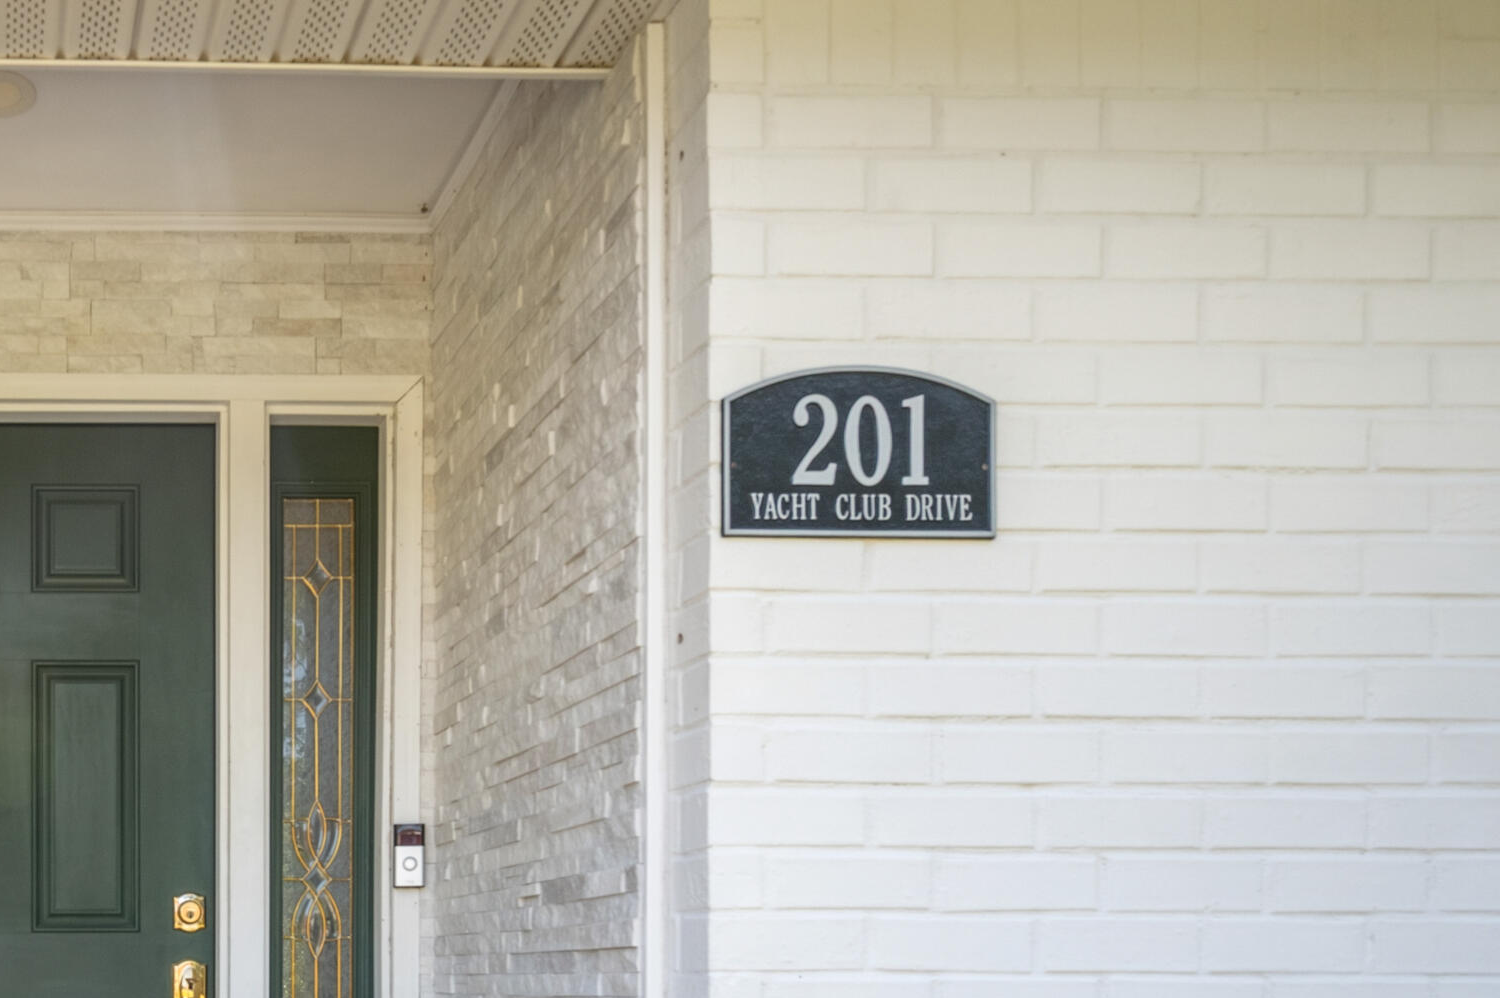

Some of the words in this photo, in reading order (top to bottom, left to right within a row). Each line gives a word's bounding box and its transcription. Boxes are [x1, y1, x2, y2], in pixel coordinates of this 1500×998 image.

[791, 393, 930, 487] 201
[750, 492, 821, 521] YACHT
[835, 493, 892, 521] CLUB
[905, 493, 973, 521] DRIVE
